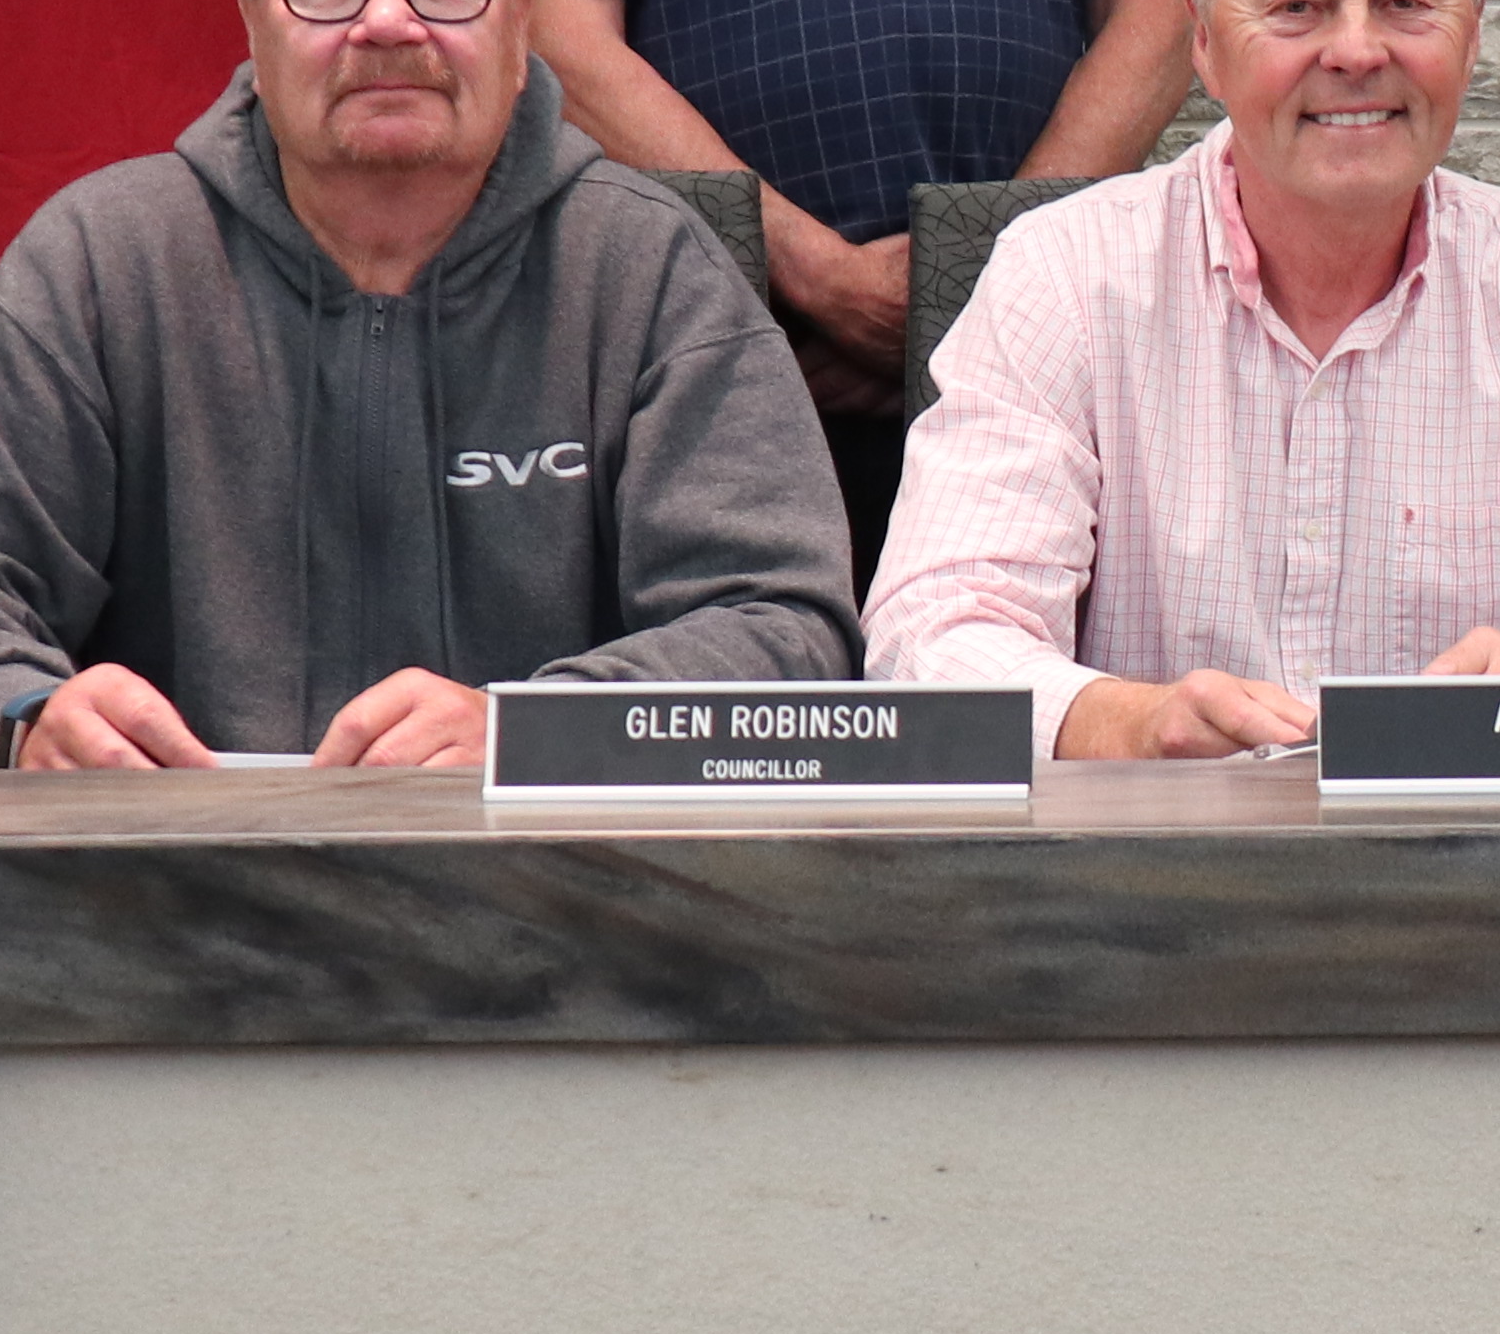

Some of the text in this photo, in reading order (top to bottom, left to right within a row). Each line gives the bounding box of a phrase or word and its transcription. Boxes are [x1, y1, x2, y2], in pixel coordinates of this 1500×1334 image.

[445, 441, 589, 488] SVC
[625, 704, 899, 740] GLEN ROBINSON
[701, 758, 822, 780] COUNCILLOR
